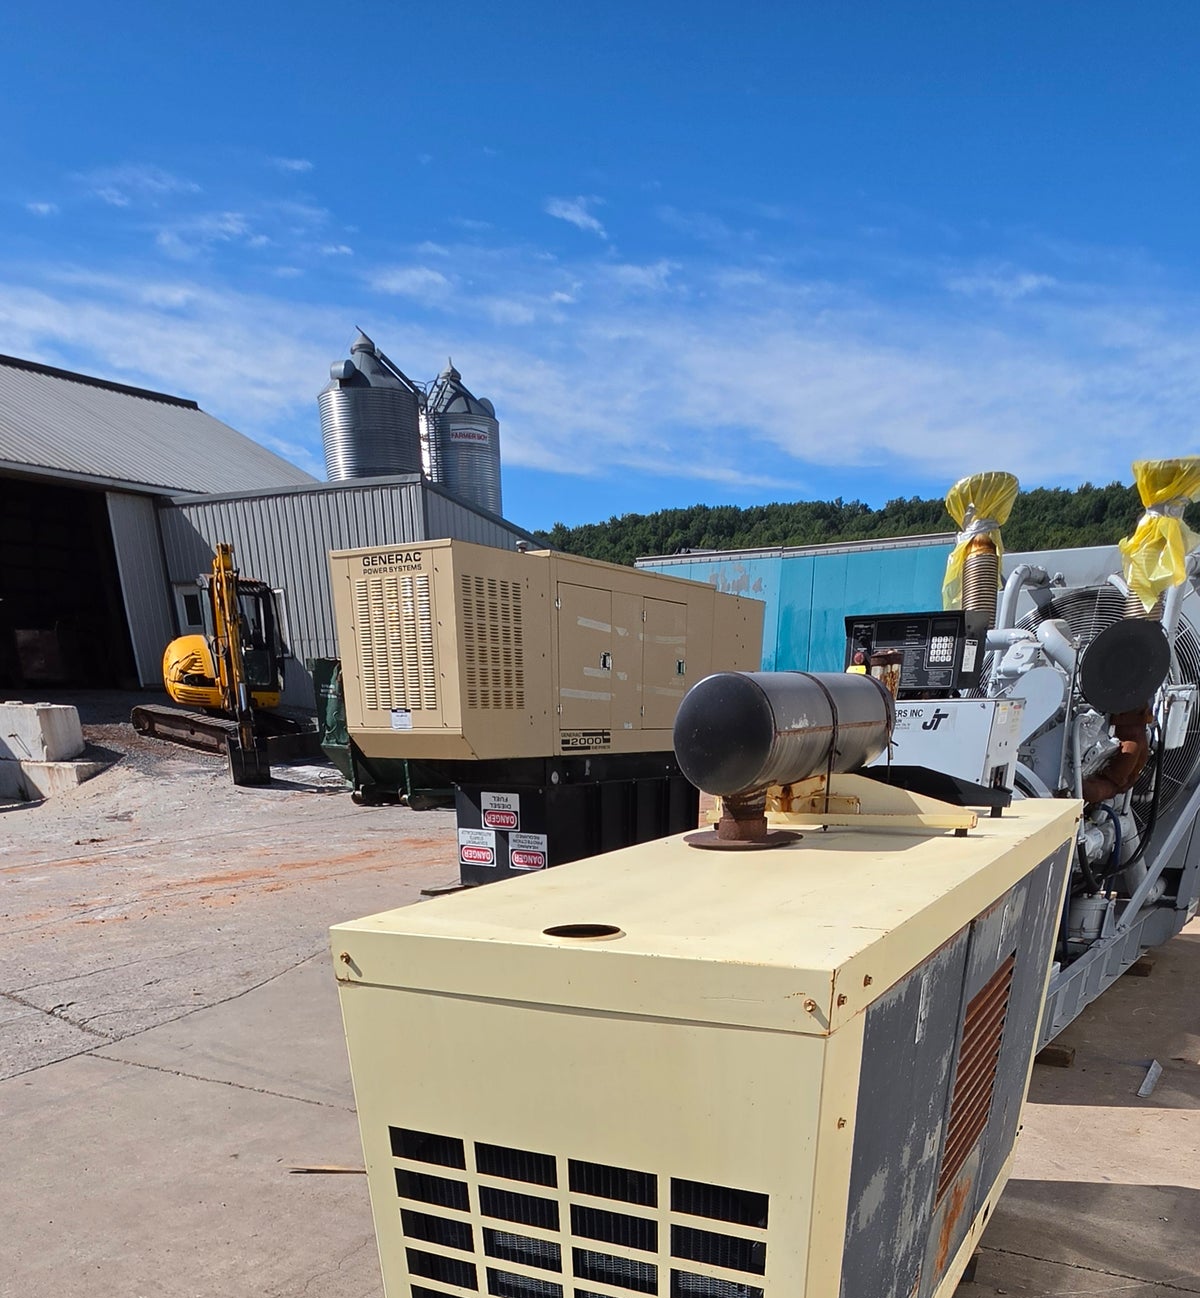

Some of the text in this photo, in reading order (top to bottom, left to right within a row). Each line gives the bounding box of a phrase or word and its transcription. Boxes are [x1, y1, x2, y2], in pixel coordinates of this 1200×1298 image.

[362, 552, 421, 566] GENERAC
[363, 564, 422, 575] POWER SYSTEMS
[910, 709, 924, 718] INC
[486, 814, 515, 824] DANGER
[464, 850, 491, 860] DANGER
[514, 854, 542, 865] DANGER
